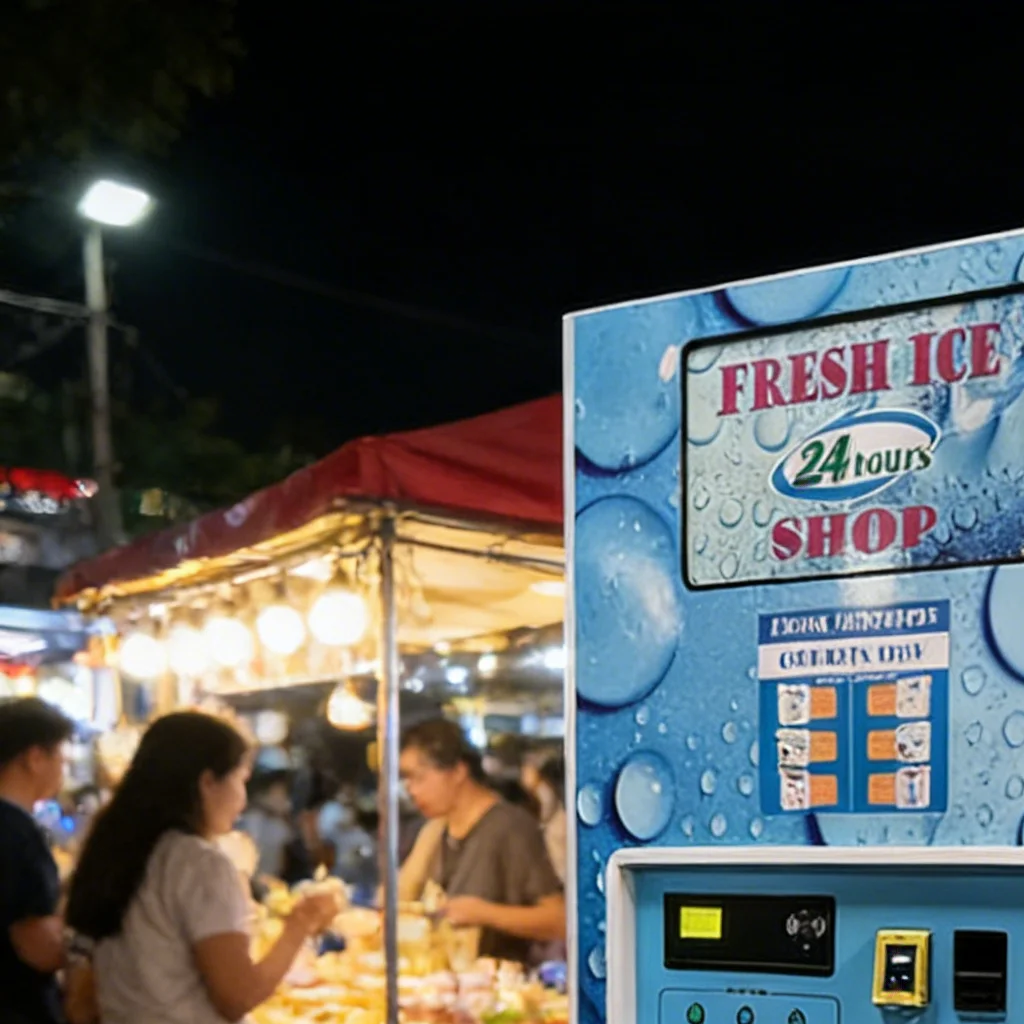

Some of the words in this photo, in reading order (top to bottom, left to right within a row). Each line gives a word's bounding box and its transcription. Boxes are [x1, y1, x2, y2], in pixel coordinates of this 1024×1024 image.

[716, 338, 890, 417] FRESH
[908, 322, 1002, 387] ICE
[791, 433, 851, 487] 24
[771, 504, 938, 561] SHOP
